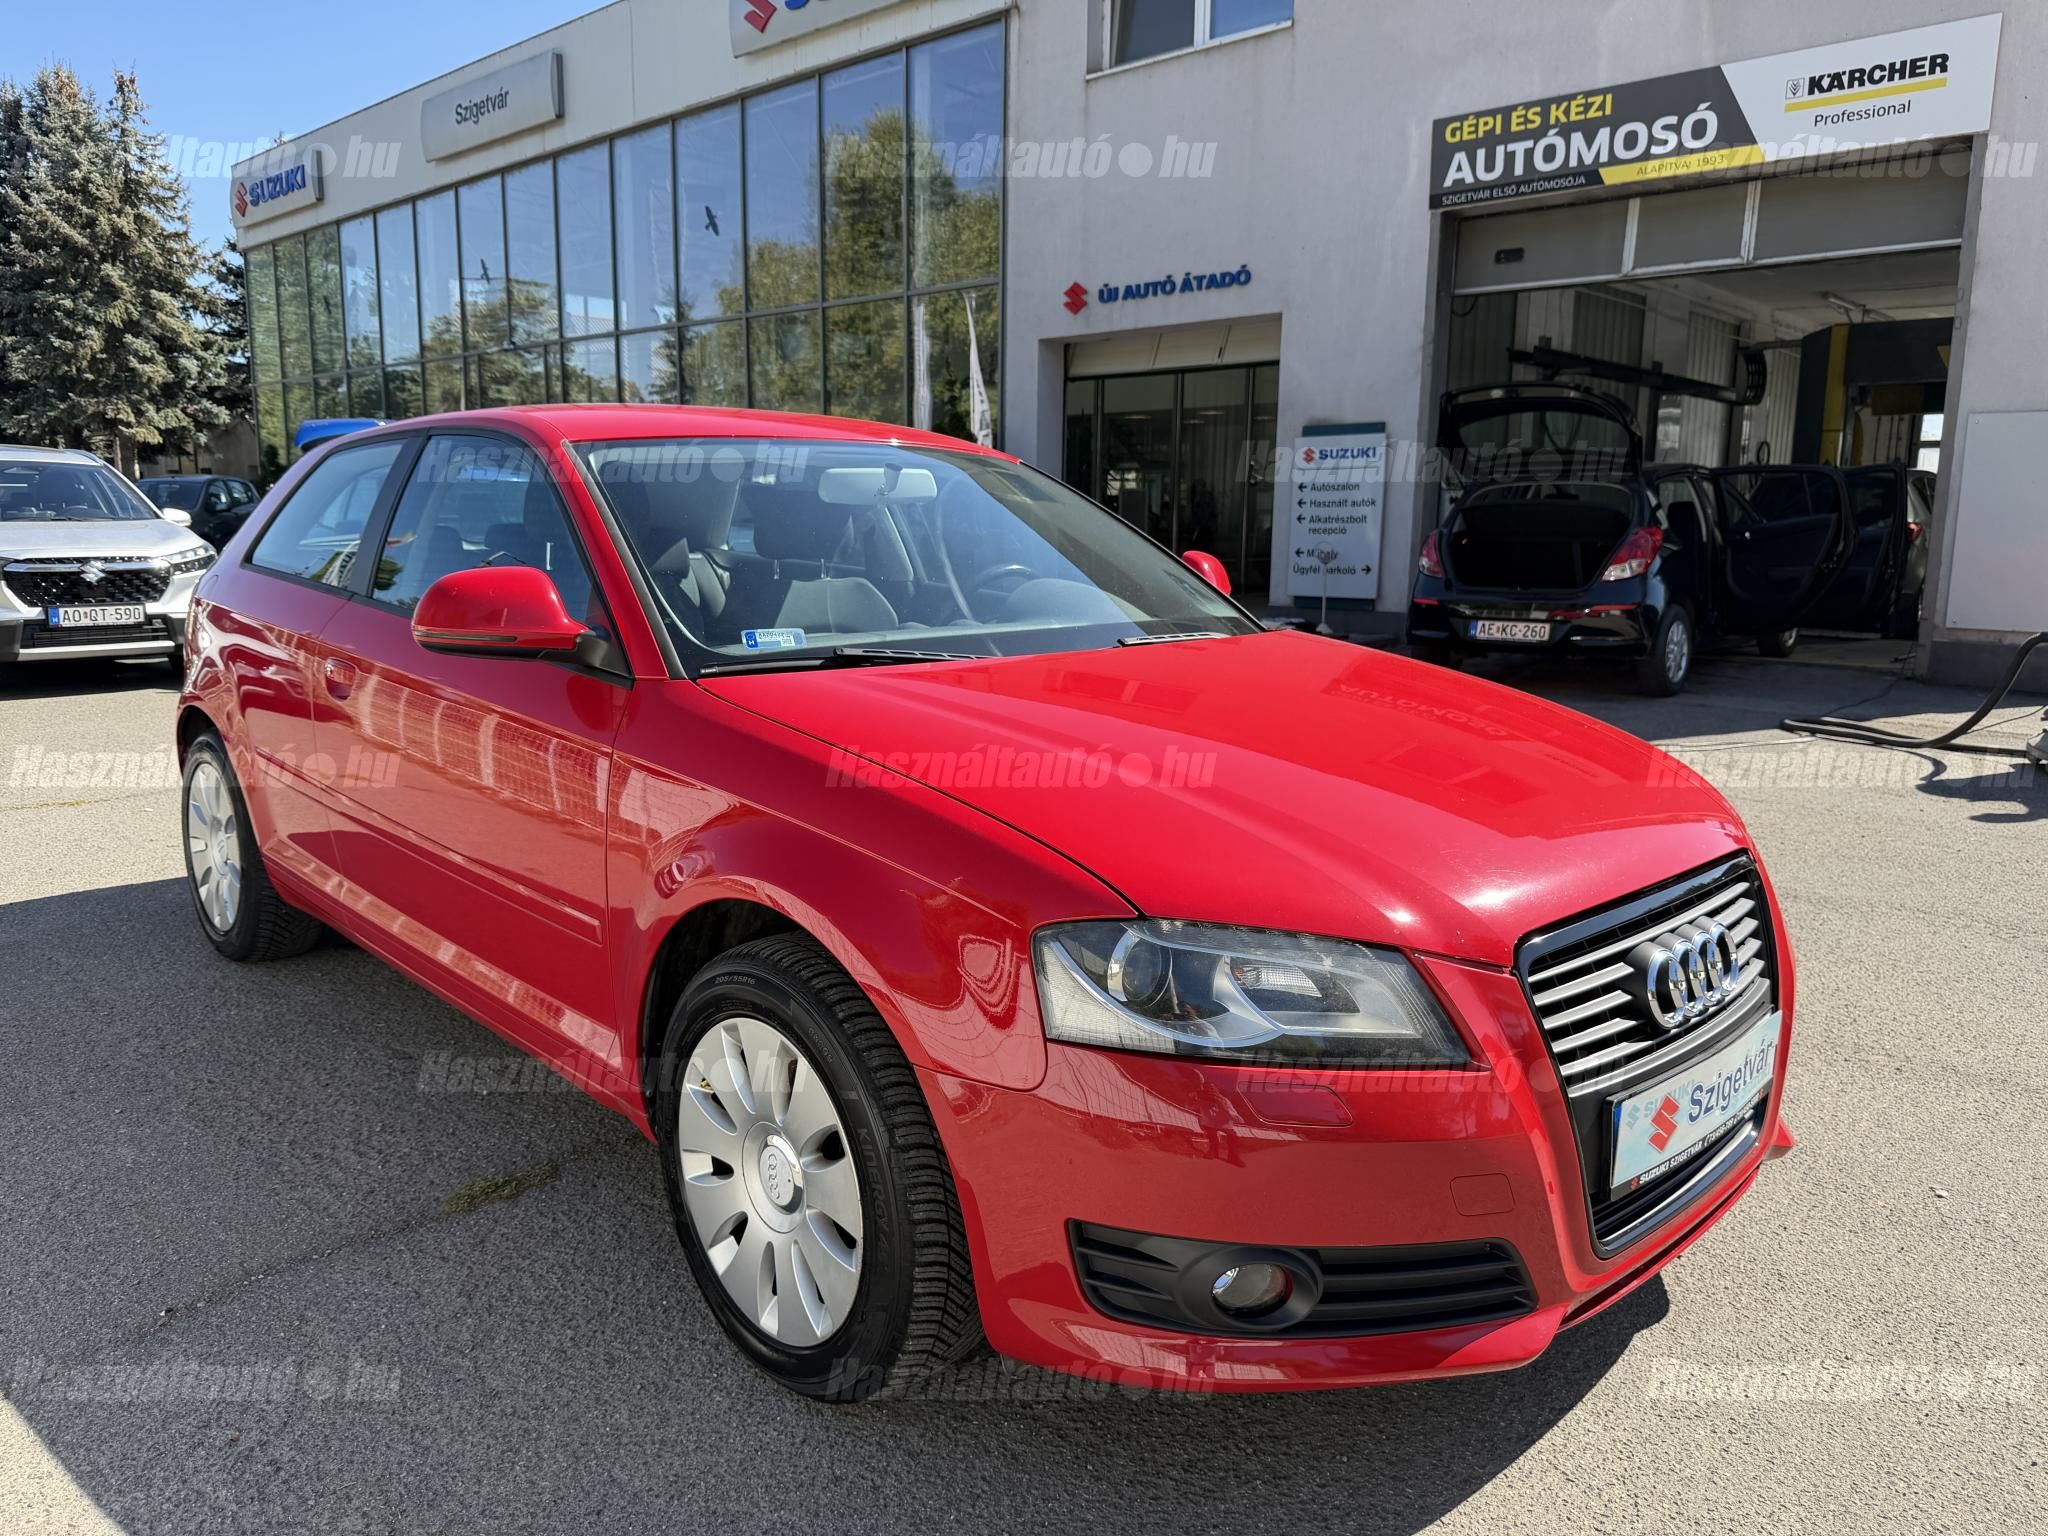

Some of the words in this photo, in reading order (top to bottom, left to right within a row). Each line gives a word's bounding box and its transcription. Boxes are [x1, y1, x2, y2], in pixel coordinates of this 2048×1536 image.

[1807, 53, 1949, 96] KÄRCHER
[454, 87, 510, 125] Szigetvár
[1445, 109, 1502, 144] GÉPI
[1510, 102, 1543, 133] ÉS
[1550, 93, 1614, 127] KÉZI
[1814, 99, 1911, 127] Professional
[1443, 102, 1719, 187] AUTÓMOSÓ
[1697, 153, 1724, 168] 1993
[248, 163, 306, 208] SUZUKI
[1122, 274, 1176, 301] AUTÓ
[1179, 263, 1252, 294] ÁTADÓ
[1318, 447, 1377, 461] SUZUKI
[1310, 482, 1360, 492] Autószalon
[1309, 498, 1348, 508] Használt
[1350, 498, 1377, 508] autók
[1308, 515, 1367, 525] Alkatrészbolt
[1308, 526, 1347, 536] recepció
[1688, 1037, 1775, 1123] Szigetvár
[1639, 1160, 1670, 1184] SUZUKI
